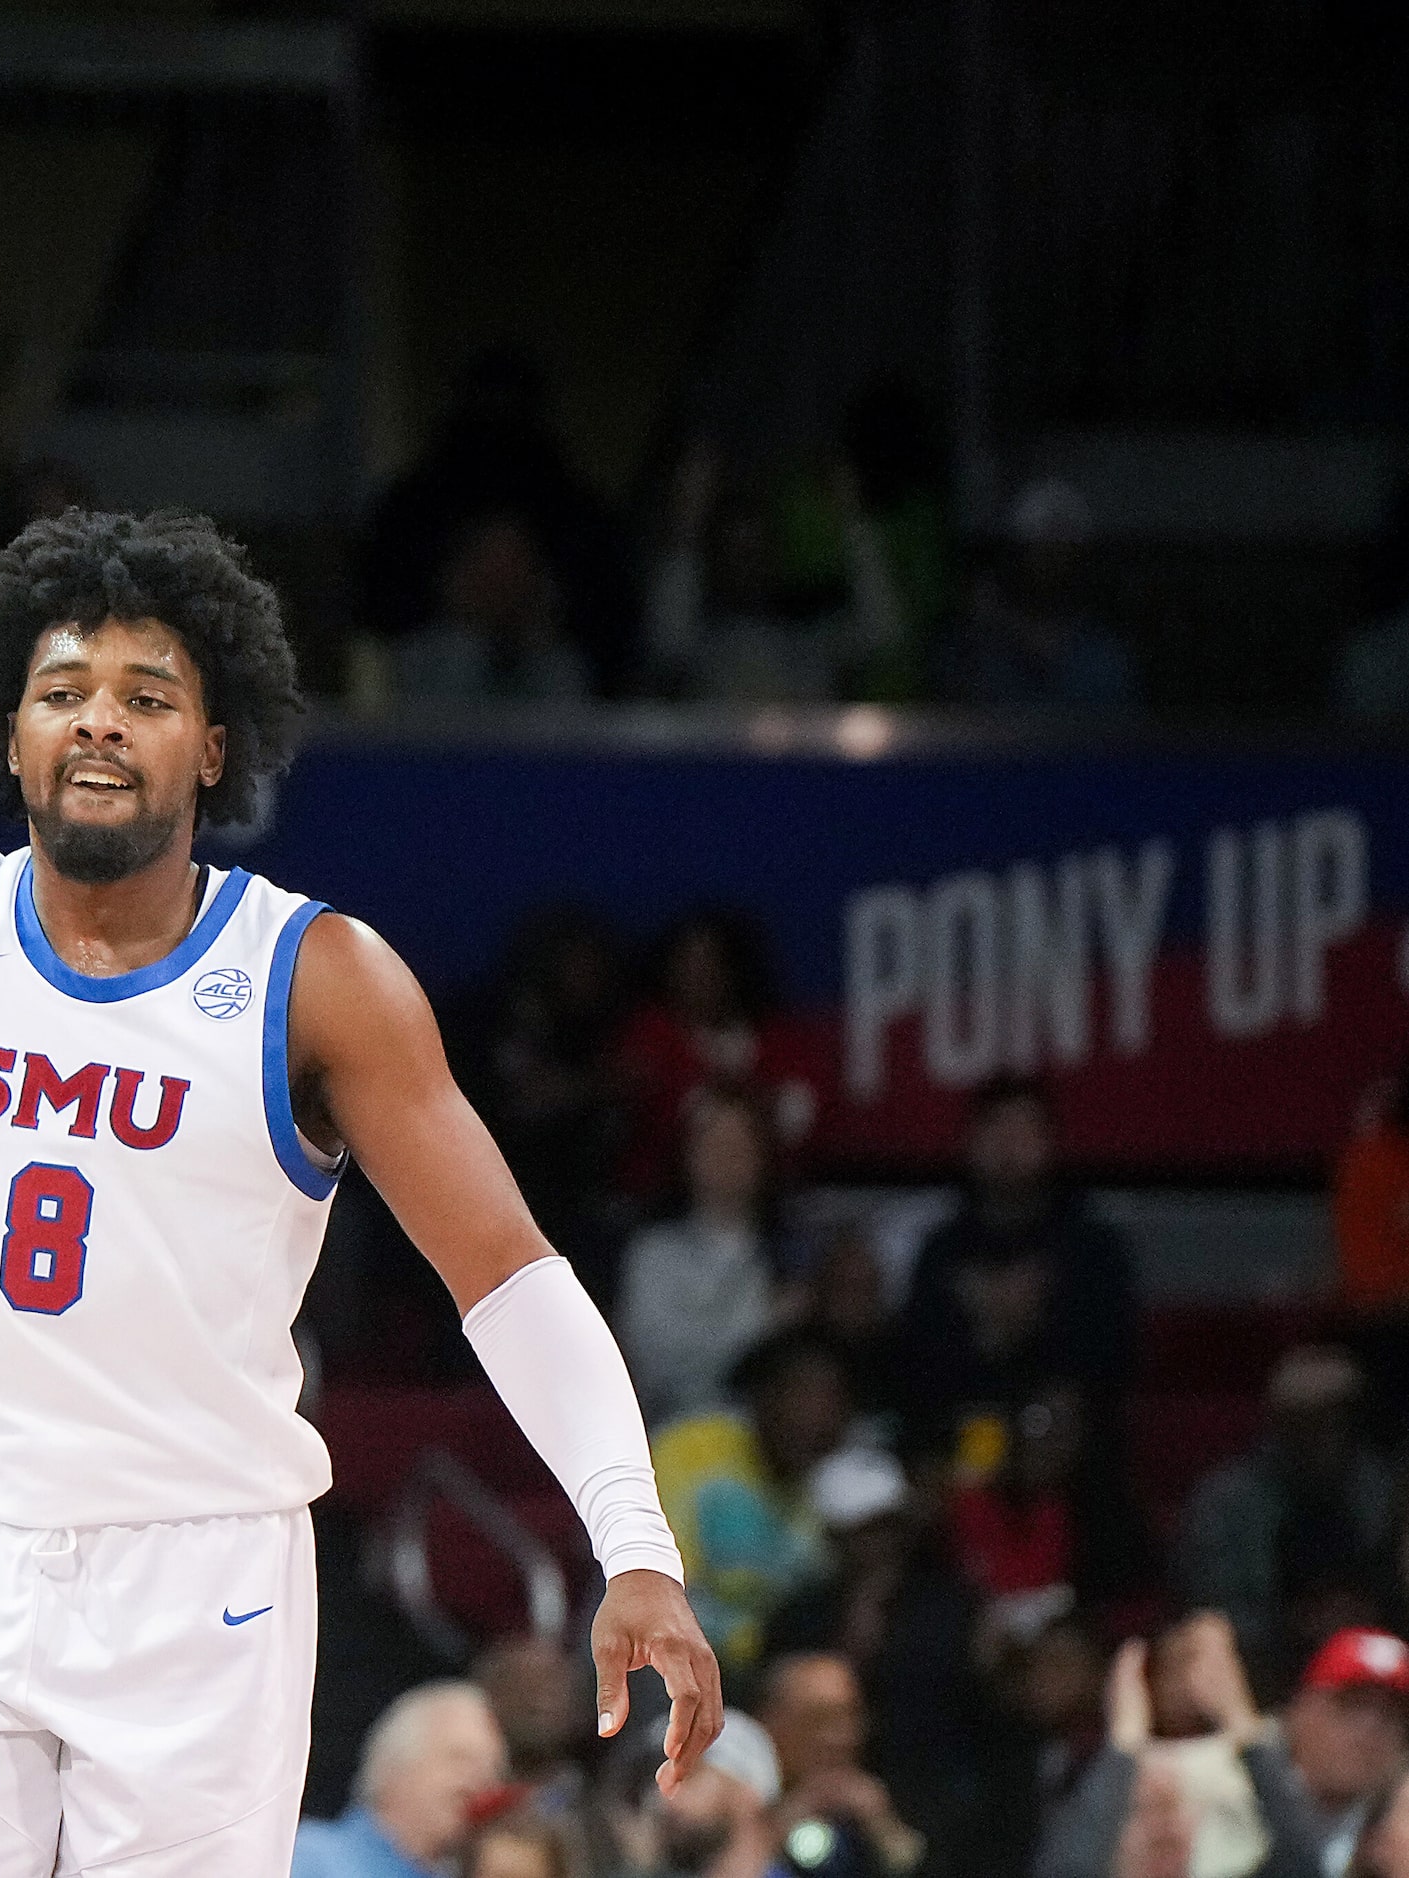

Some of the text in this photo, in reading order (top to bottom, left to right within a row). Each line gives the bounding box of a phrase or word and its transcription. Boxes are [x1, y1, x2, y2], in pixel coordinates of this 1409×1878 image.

[199, 982, 251, 997] ACC
[846, 806, 1368, 1104] PONY UP
